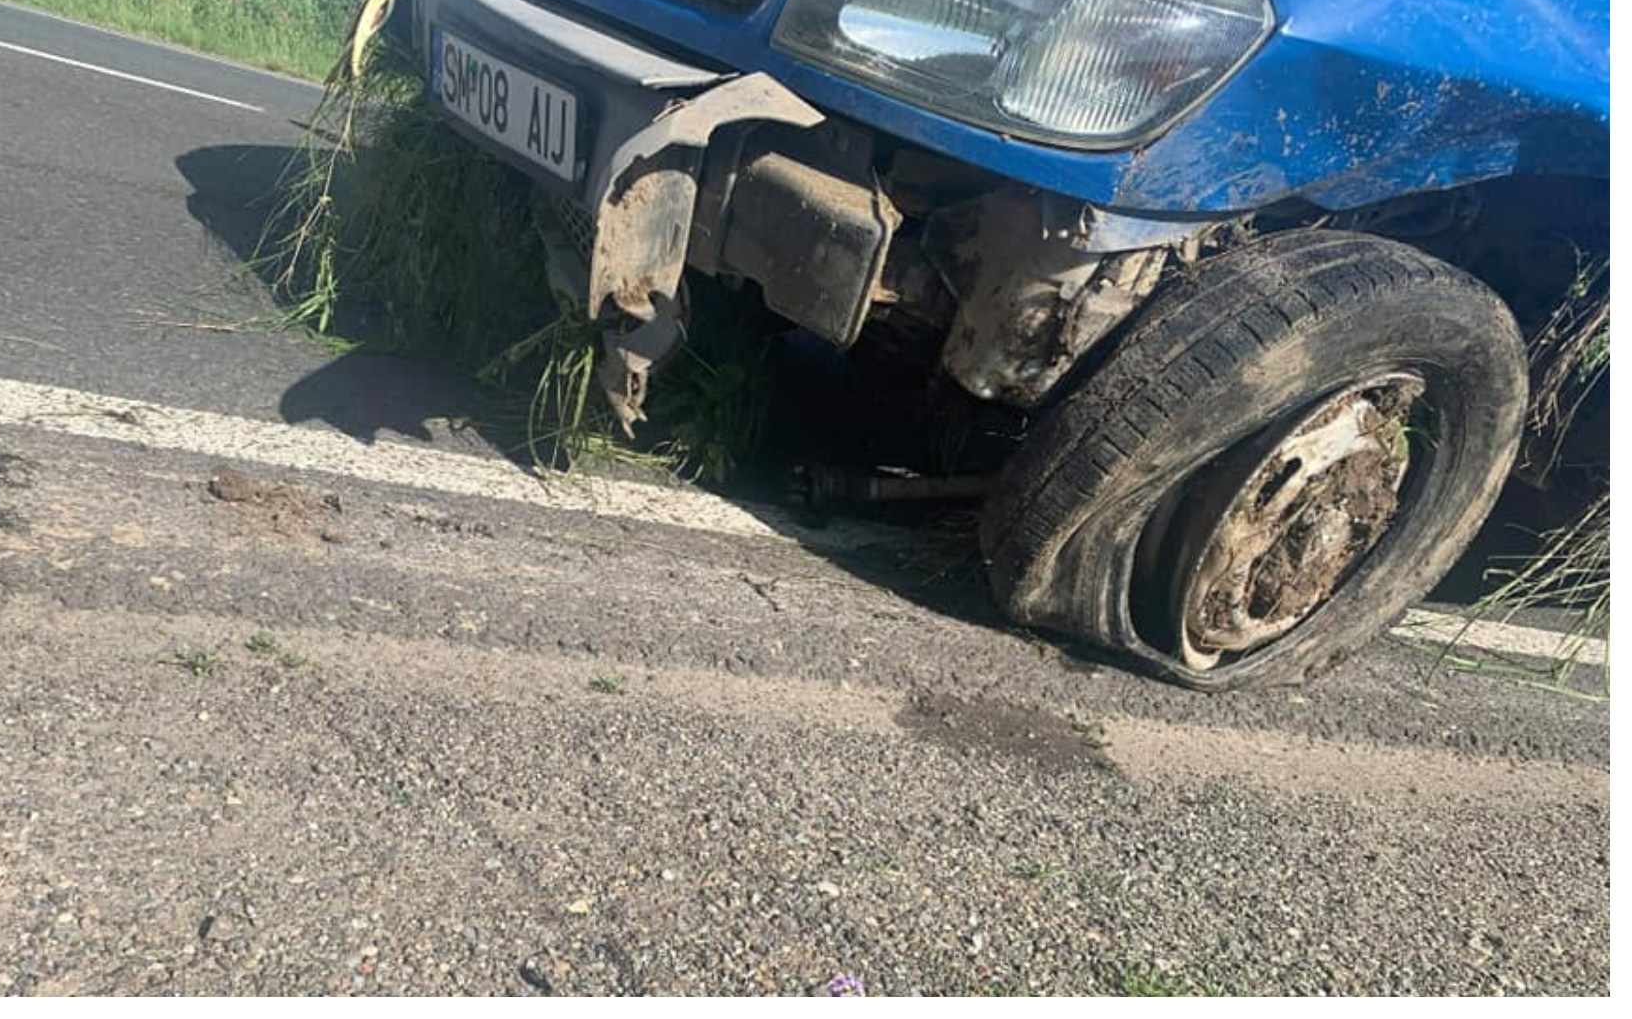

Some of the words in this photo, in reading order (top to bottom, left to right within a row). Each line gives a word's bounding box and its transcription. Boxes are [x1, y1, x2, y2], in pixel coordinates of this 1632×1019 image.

[444, 42, 471, 115] SM
[478, 62, 510, 134] 08
[528, 85, 567, 166] AIJ
